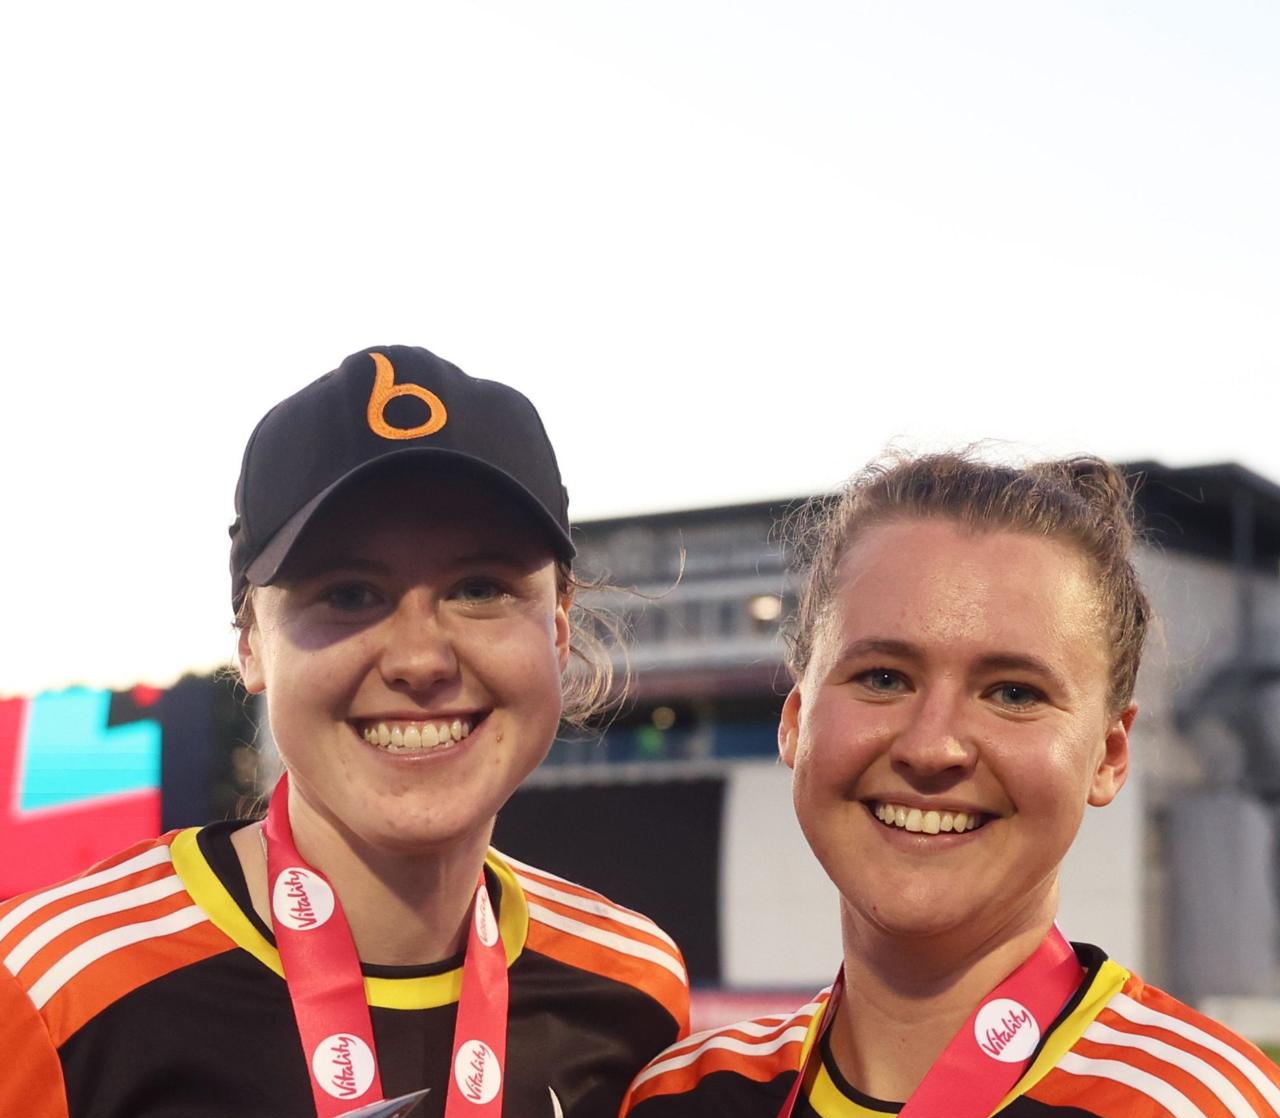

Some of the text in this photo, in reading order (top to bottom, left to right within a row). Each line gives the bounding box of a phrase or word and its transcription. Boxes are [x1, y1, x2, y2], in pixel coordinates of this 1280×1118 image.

[285, 870, 317, 928] Vitality
[982, 1009, 1033, 1056] Vitality
[331, 1036, 357, 1098] Vitality
[465, 1043, 491, 1100] Vitality
